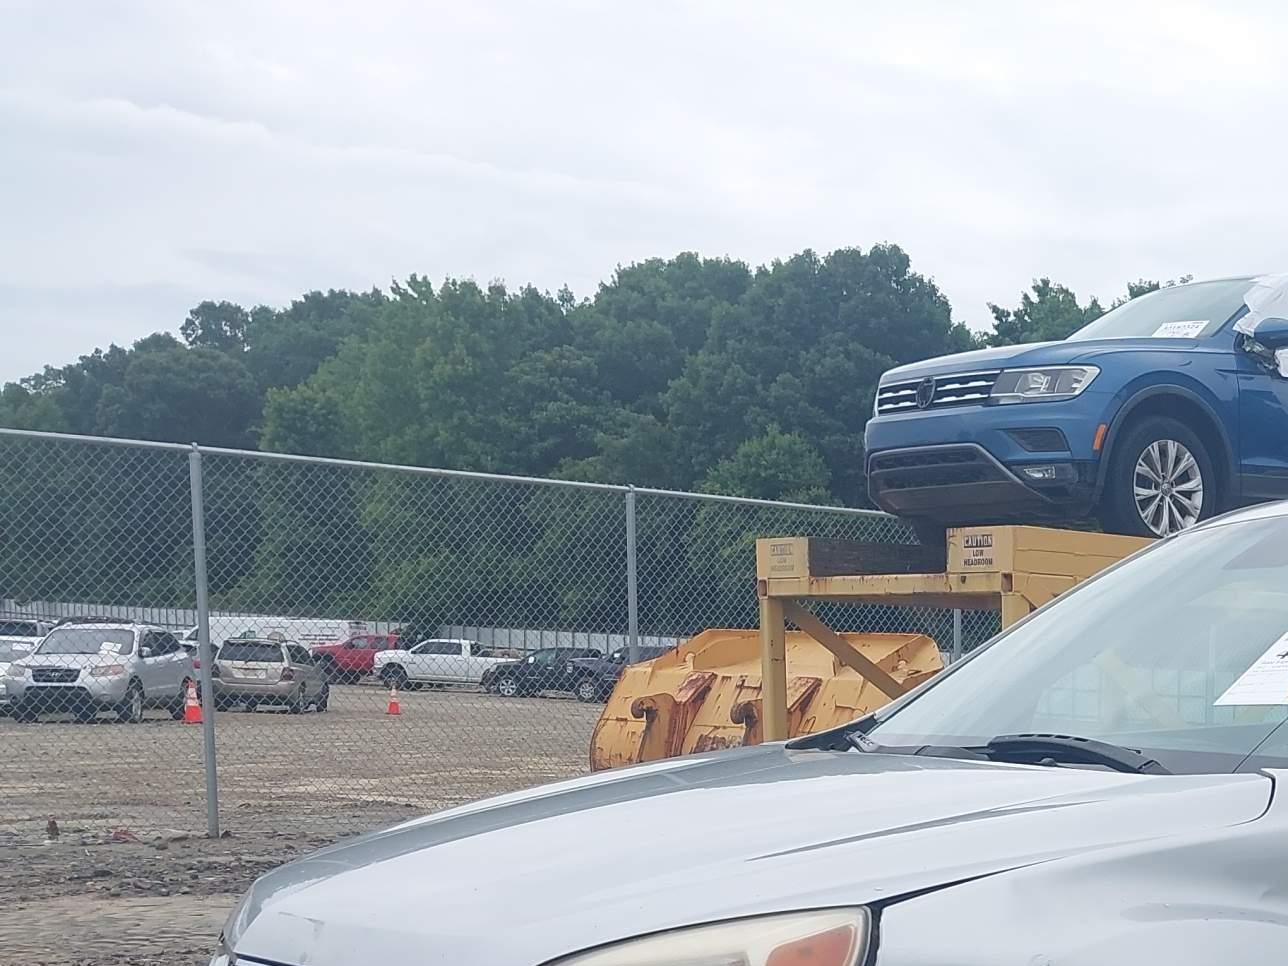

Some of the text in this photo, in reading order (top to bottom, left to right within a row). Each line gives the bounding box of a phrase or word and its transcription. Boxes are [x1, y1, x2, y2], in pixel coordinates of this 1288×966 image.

[964, 535, 992, 546] CAUTION
[972, 549, 984, 557] LOW
[964, 558, 993, 566] HEADROOM
